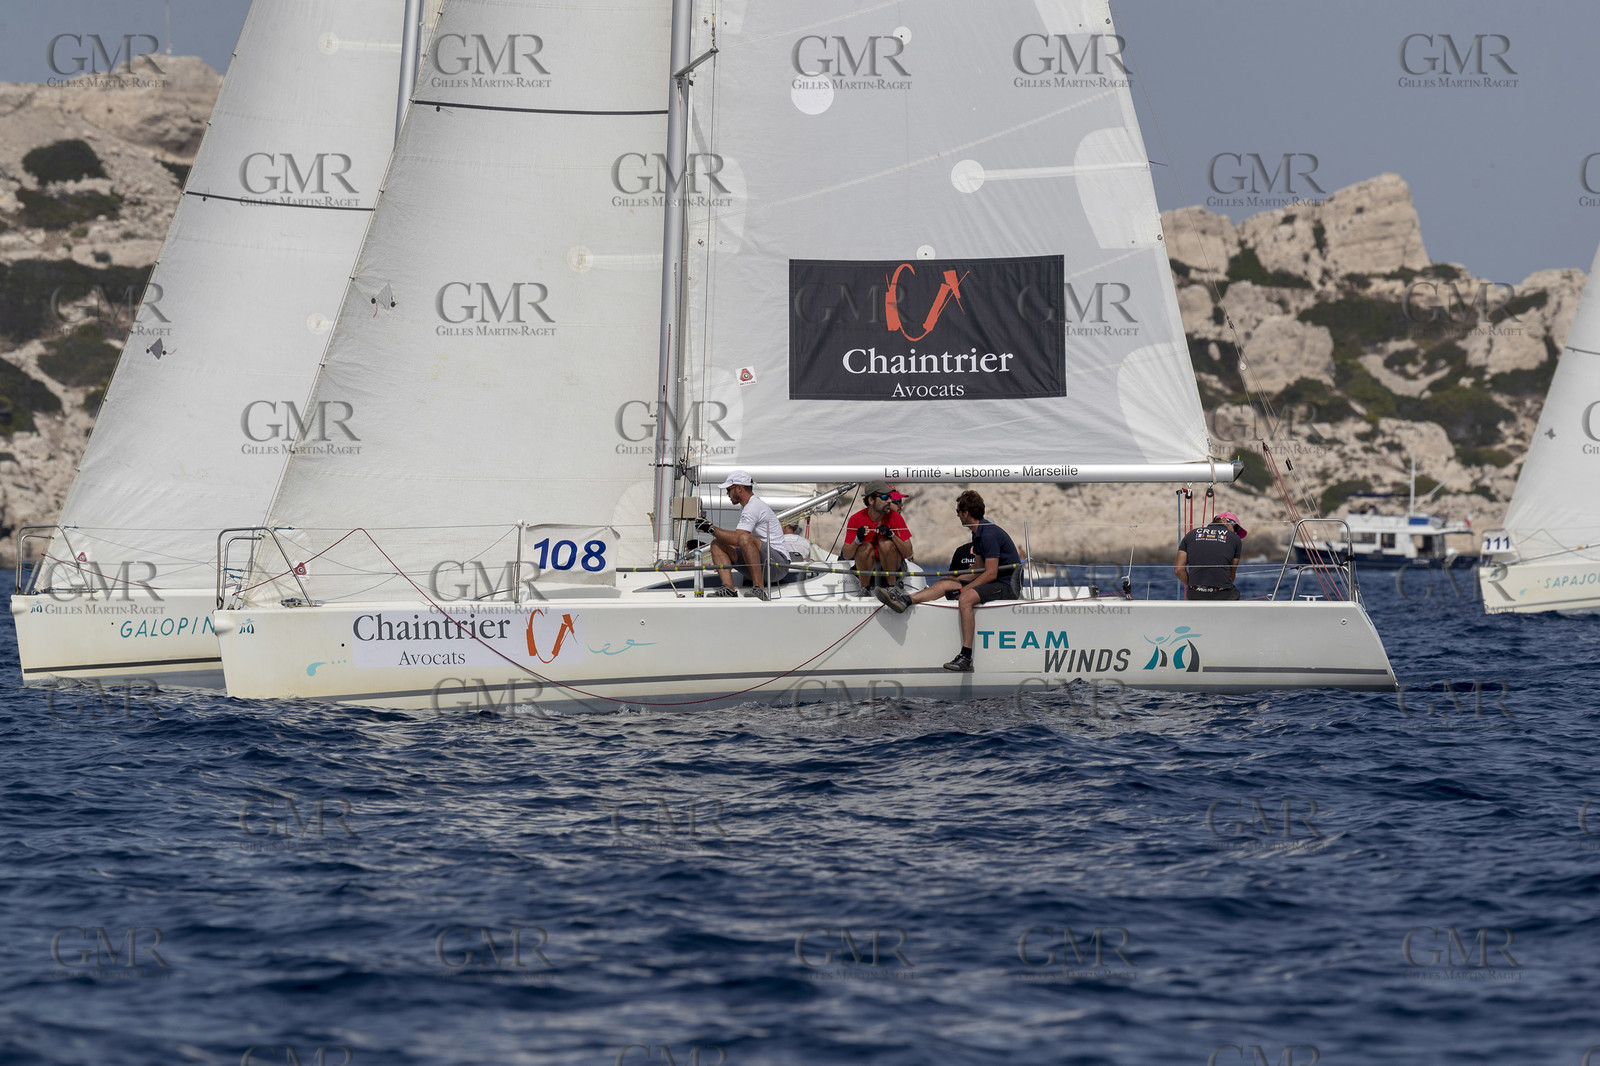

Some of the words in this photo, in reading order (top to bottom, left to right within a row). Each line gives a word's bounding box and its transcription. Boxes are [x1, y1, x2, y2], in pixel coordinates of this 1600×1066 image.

[842, 347, 1014, 374] Chaintrier
[891, 382, 965, 398] Avocats
[884, 467, 900, 478] La
[904, 467, 942, 478] Trinité
[954, 467, 1010, 478] Lisbonne
[1022, 465, 1078, 477] Marseille
[1196, 528, 1228, 536] CREW
[1486, 536, 1510, 550] 111
[534, 538, 606, 572] 108
[1544, 573, 1600, 589] SAPAJO
[353, 614, 510, 641] Chaintrier
[977, 631, 1070, 649] TEAM
[398, 651, 466, 666] Avocats
[1044, 648, 1131, 673] WINDS
